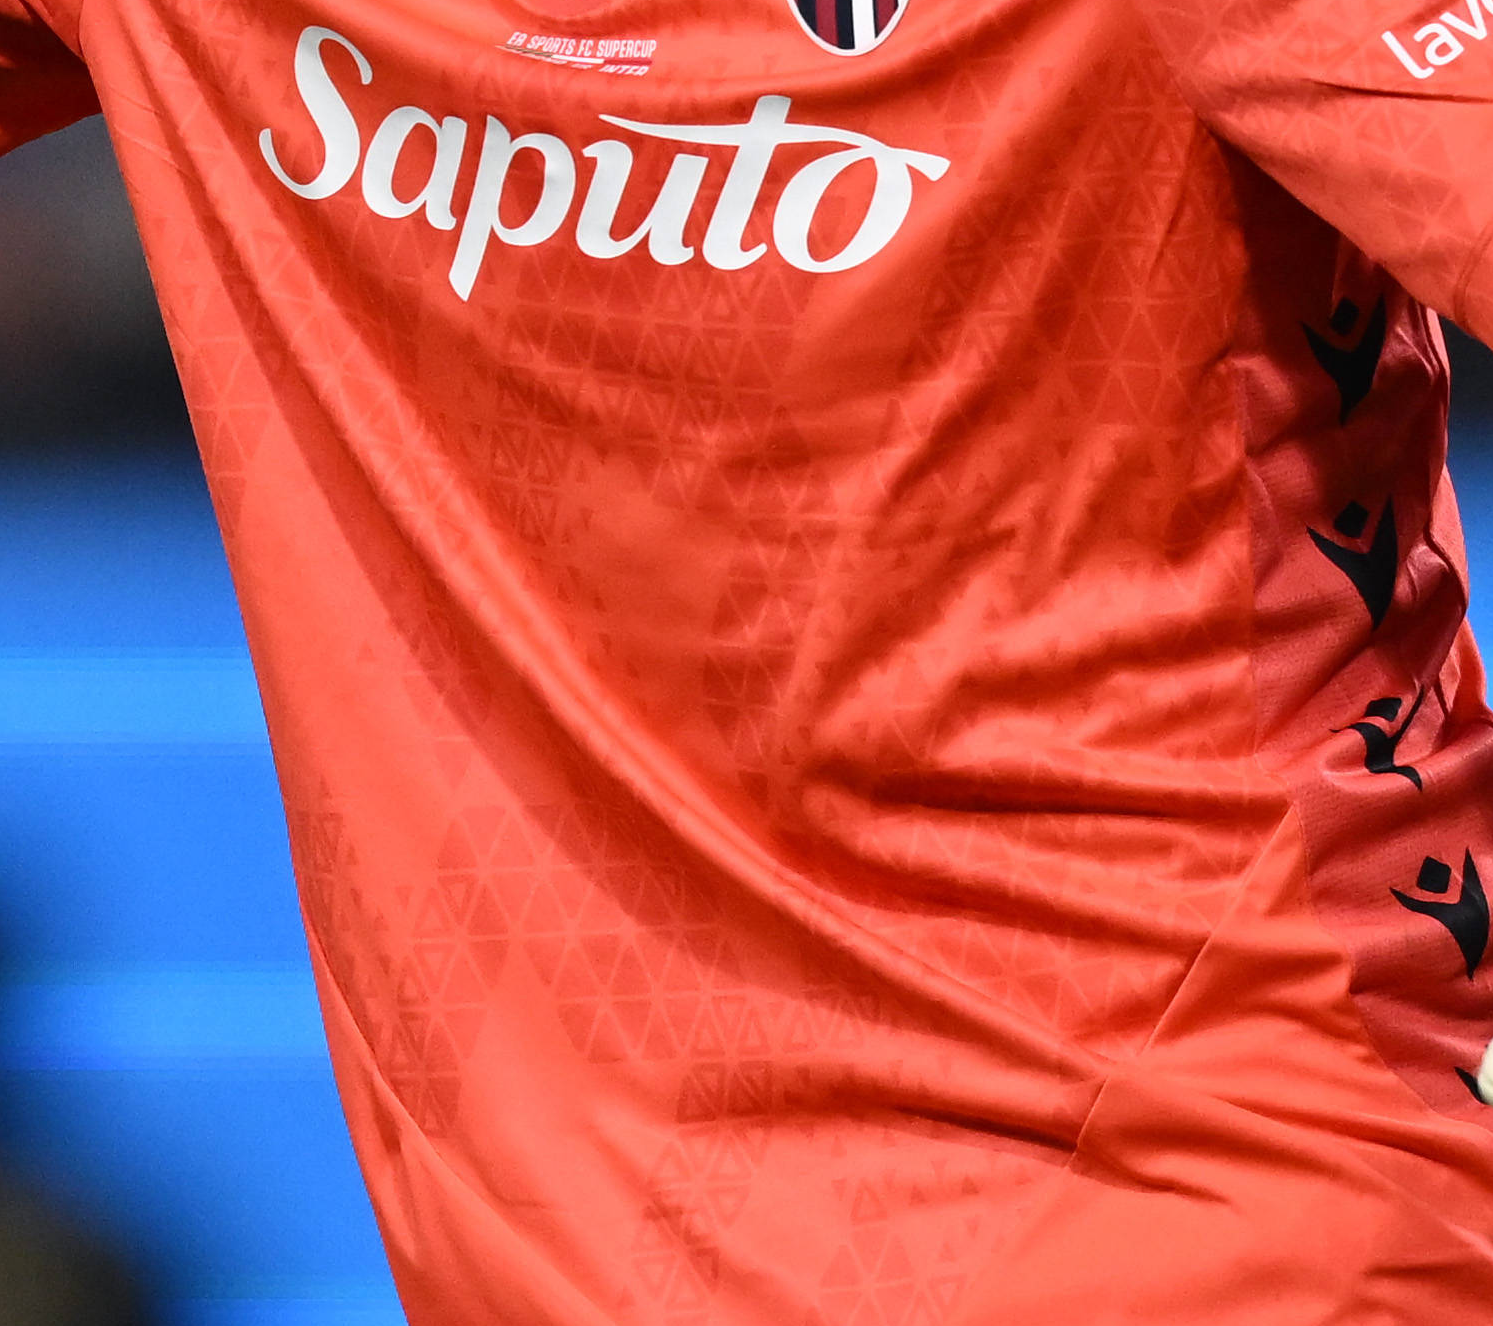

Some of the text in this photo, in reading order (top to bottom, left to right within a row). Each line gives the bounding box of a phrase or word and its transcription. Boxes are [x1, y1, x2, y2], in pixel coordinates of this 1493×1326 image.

[506, 31, 657, 58] EA SPORTS FC SUPERCUP
[259, 26, 951, 302] Saputo
